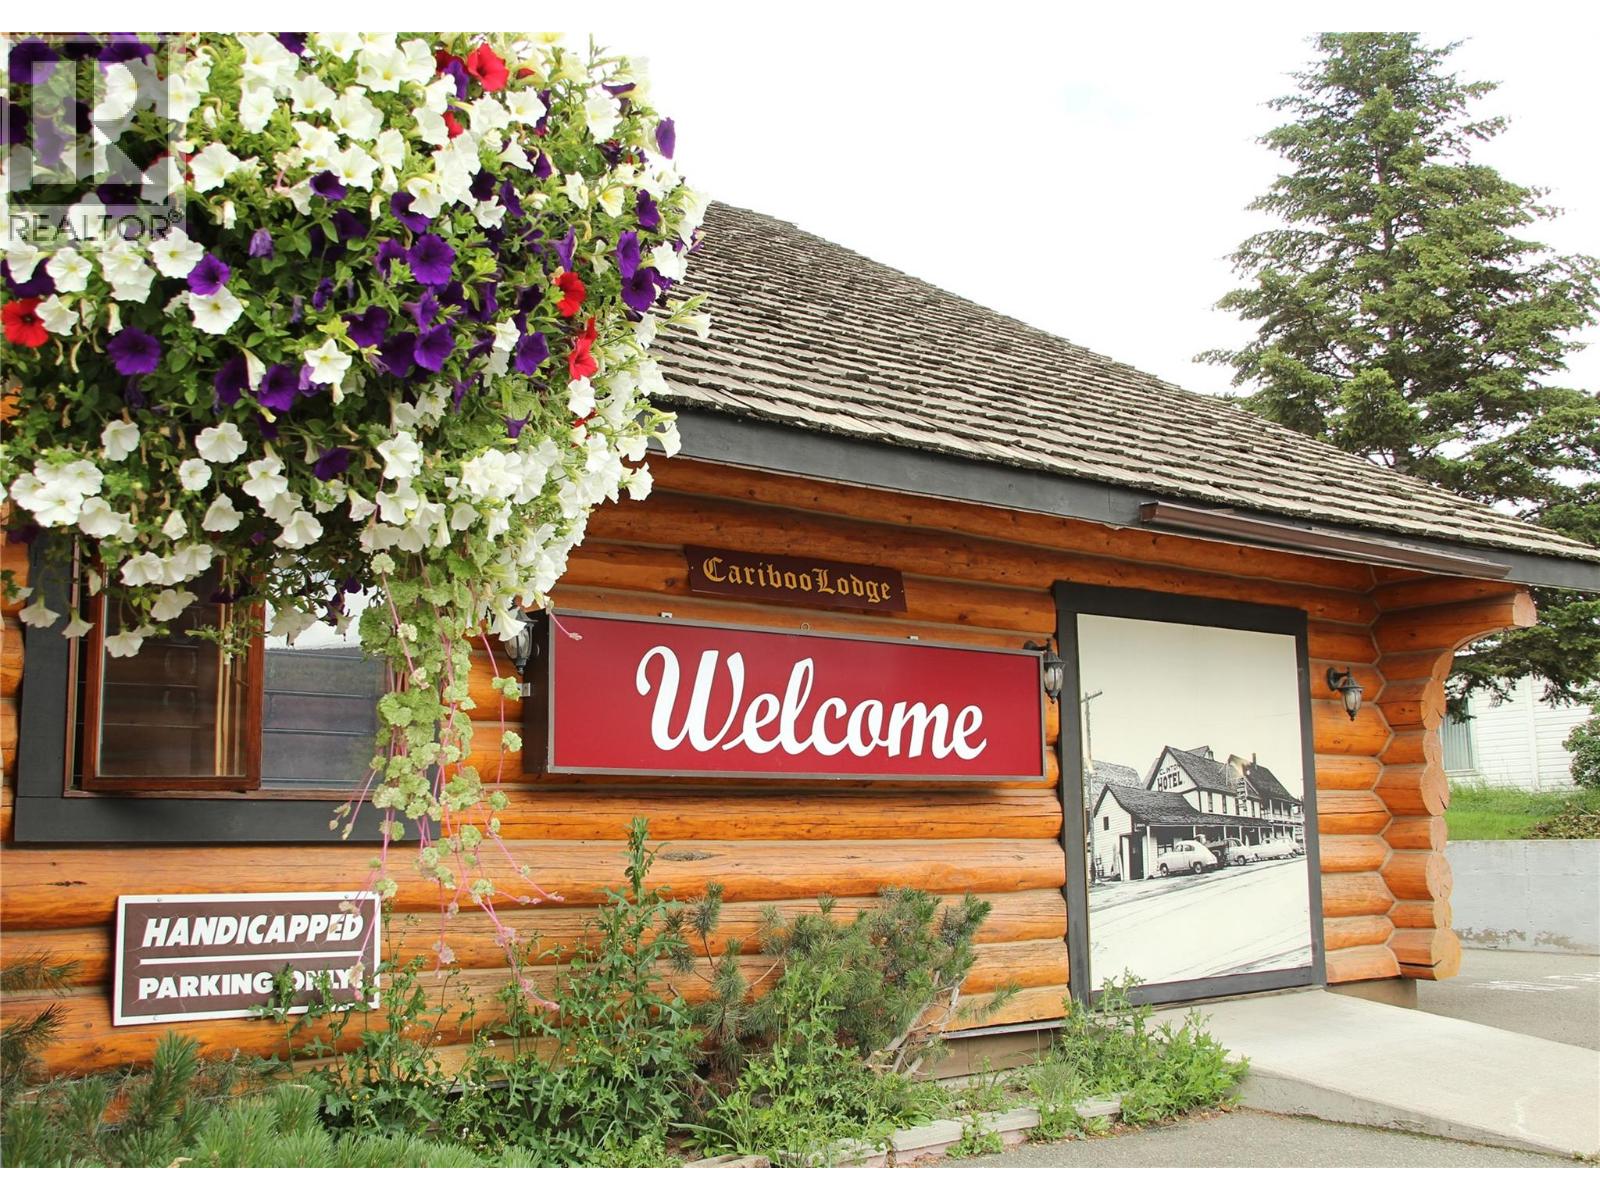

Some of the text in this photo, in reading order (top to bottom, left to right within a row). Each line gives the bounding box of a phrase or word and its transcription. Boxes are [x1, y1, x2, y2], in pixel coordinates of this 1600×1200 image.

[635, 645, 987, 760] Welcome
[1157, 770, 1182, 792] HOTEL
[142, 913, 364, 948] HANDICAPPED
[138, 971, 274, 1000] PARKING
